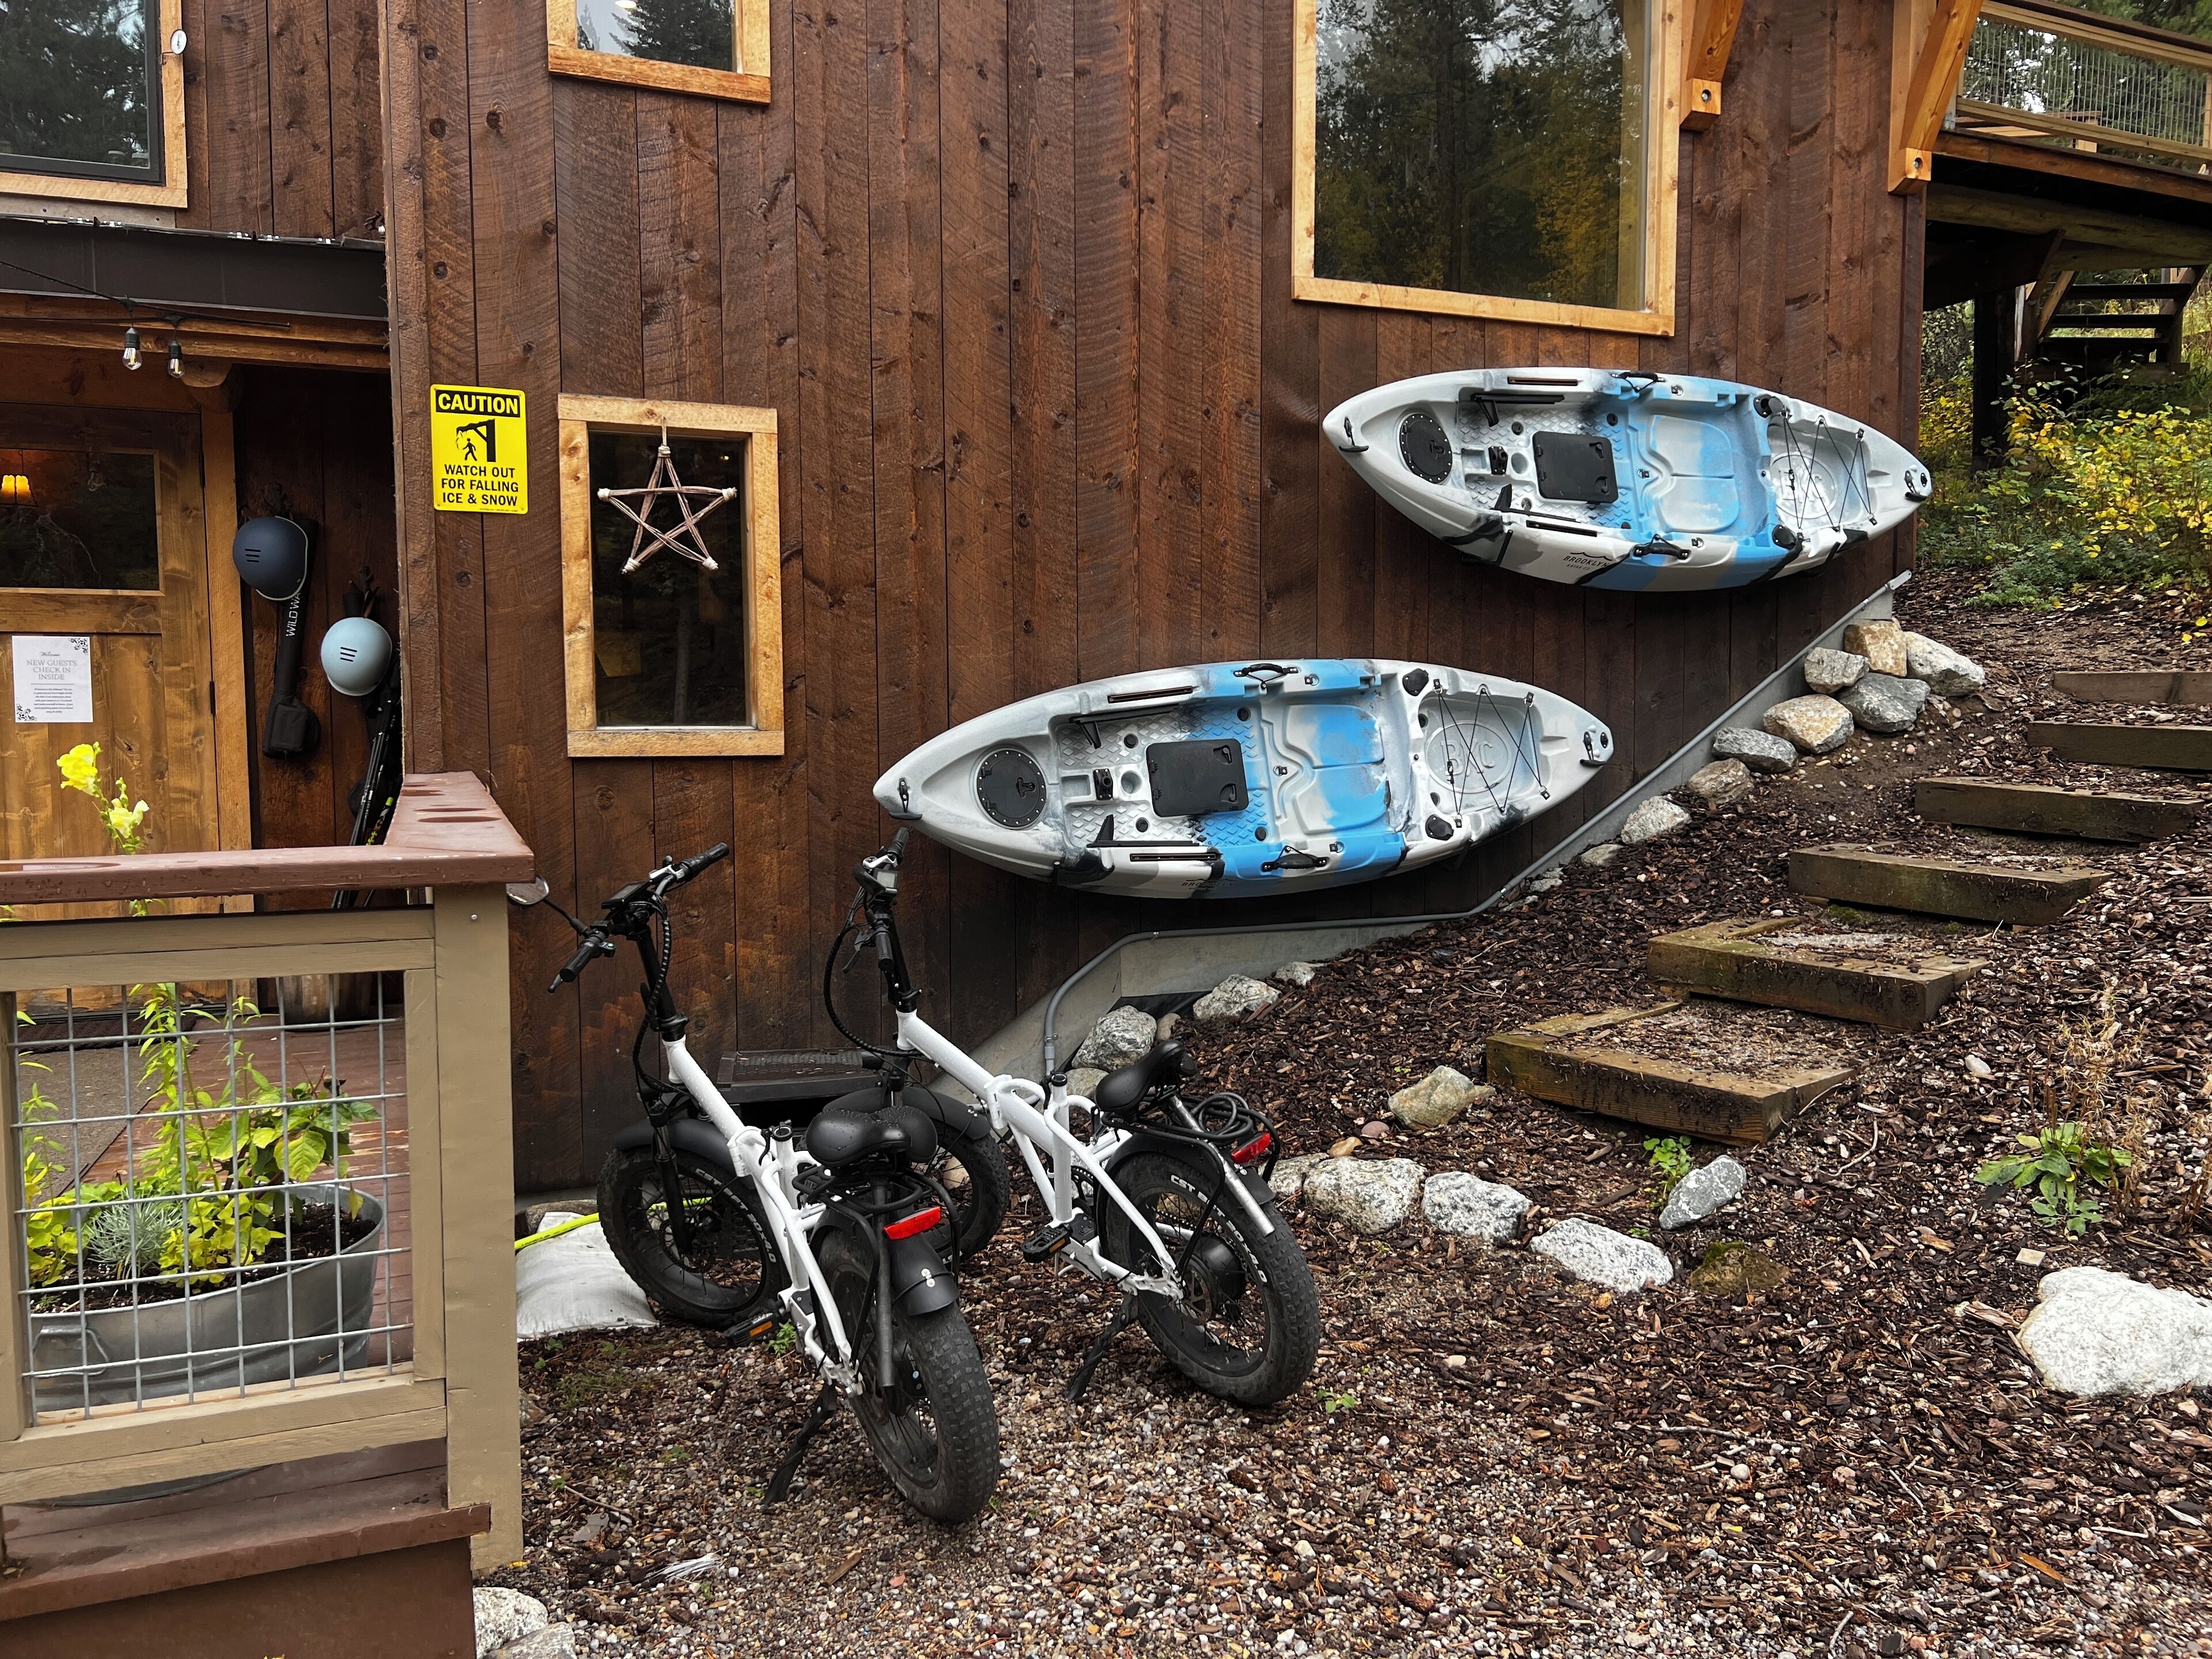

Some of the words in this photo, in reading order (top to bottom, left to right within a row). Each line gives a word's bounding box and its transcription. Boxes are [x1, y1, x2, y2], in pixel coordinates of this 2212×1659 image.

[438, 393, 518, 415] CAUTION
[444, 464, 487, 476] WATCH
[491, 467, 516, 478] OUT
[441, 478, 465, 490] FOR
[469, 480, 518, 493] FALLING
[442, 493, 463, 503] ICE
[467, 493, 477, 504] &
[481, 494, 517, 506] SNOW
[1563, 555, 1609, 567] BROOKLYN
[286, 611, 298, 637] WILD
[695, 1168, 722, 1185] CST
[1171, 1174, 1196, 1193] CST
